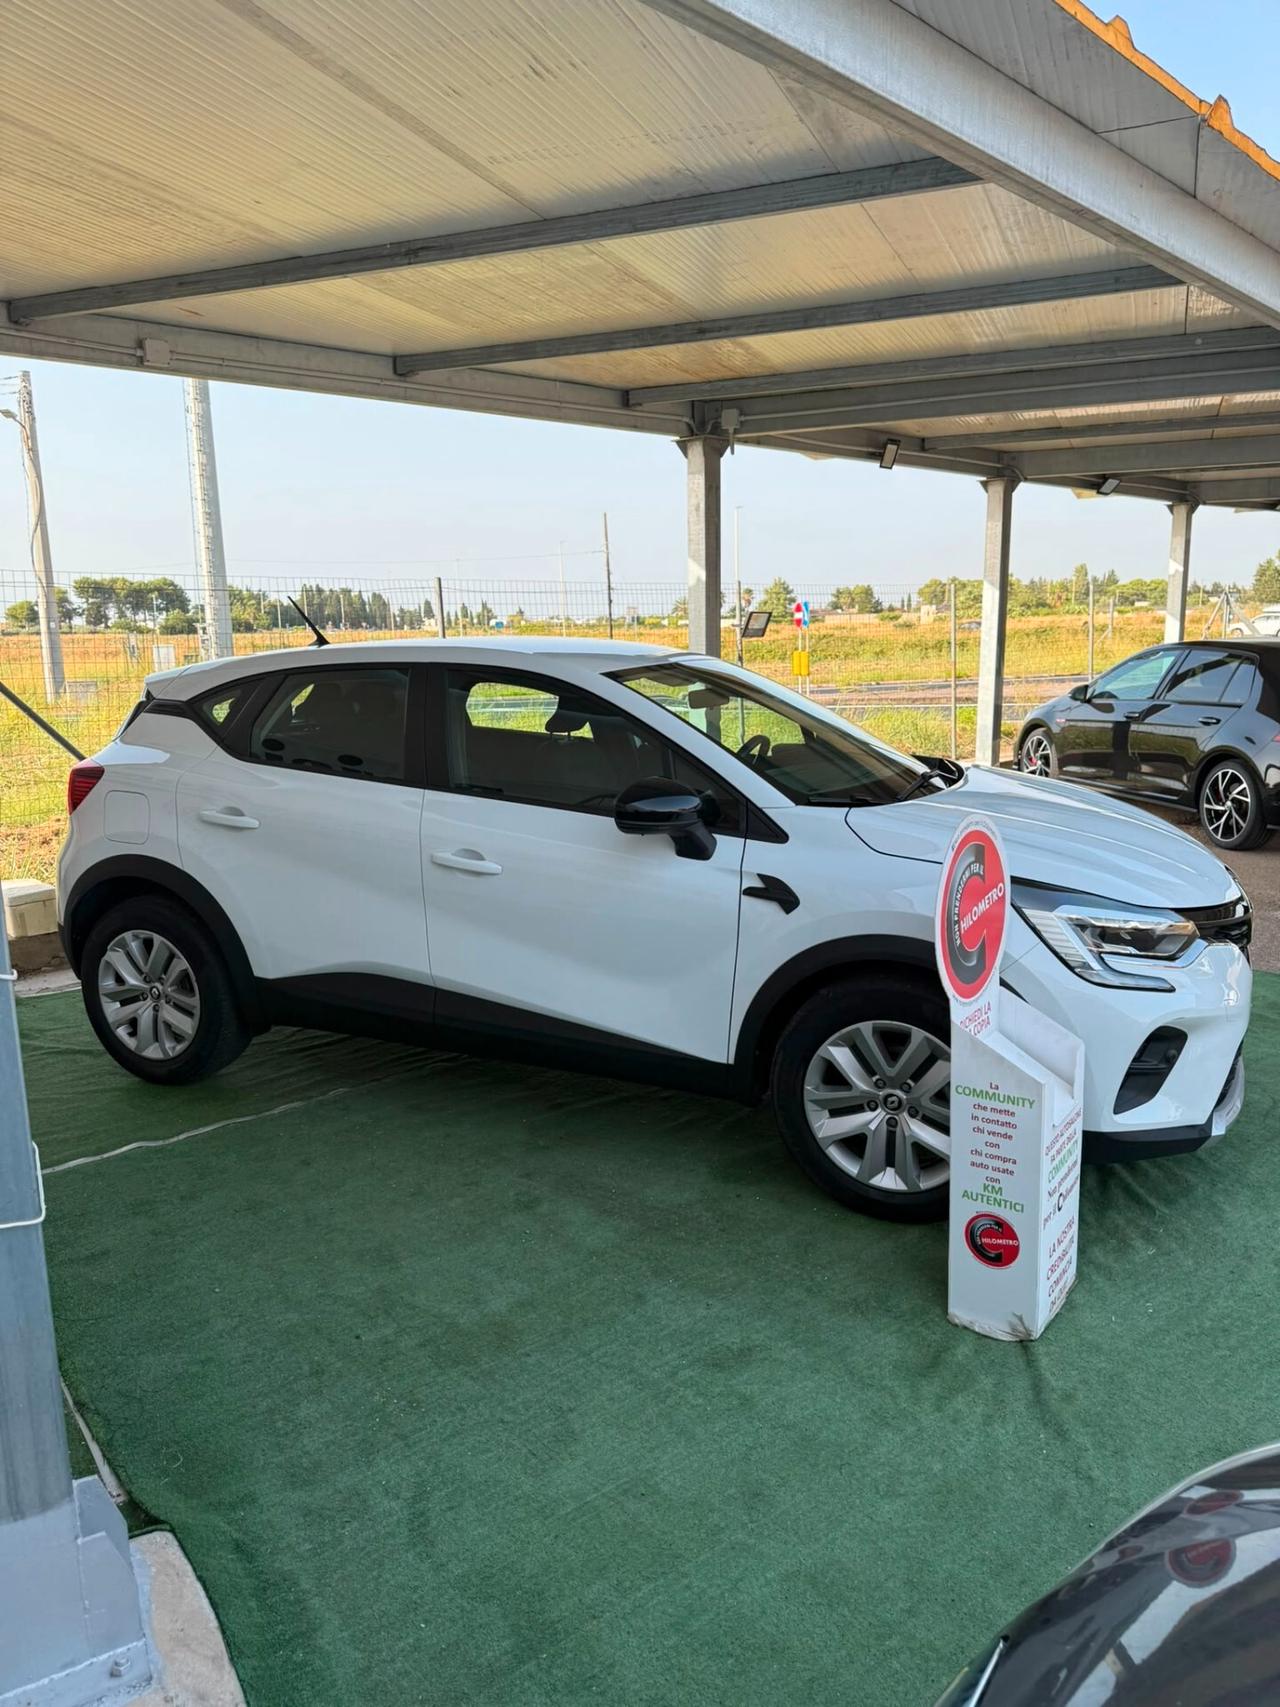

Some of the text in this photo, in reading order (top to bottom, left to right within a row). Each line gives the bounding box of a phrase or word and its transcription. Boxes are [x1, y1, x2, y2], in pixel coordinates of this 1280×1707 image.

[960, 883, 1004, 934] HILOMETRO
[984, 1001, 991, 1015] LA
[989, 1082, 999, 1091] La
[955, 1084, 1035, 1109] COMMUNITY
[973, 1102, 1016, 1118] che mette
[971, 1113, 1017, 1130] in contatto
[972, 1126, 1013, 1141] chi vende
[985, 1141, 1000, 1150] con
[970, 1148, 1017, 1166] chi compra
[970, 1160, 1015, 1177] auto usate
[985, 1175, 1001, 1185] con
[983, 1183, 1003, 1197] KM
[962, 1189, 1024, 1213] AUTENTICI
[982, 1237, 1018, 1247] HILOMETRO
